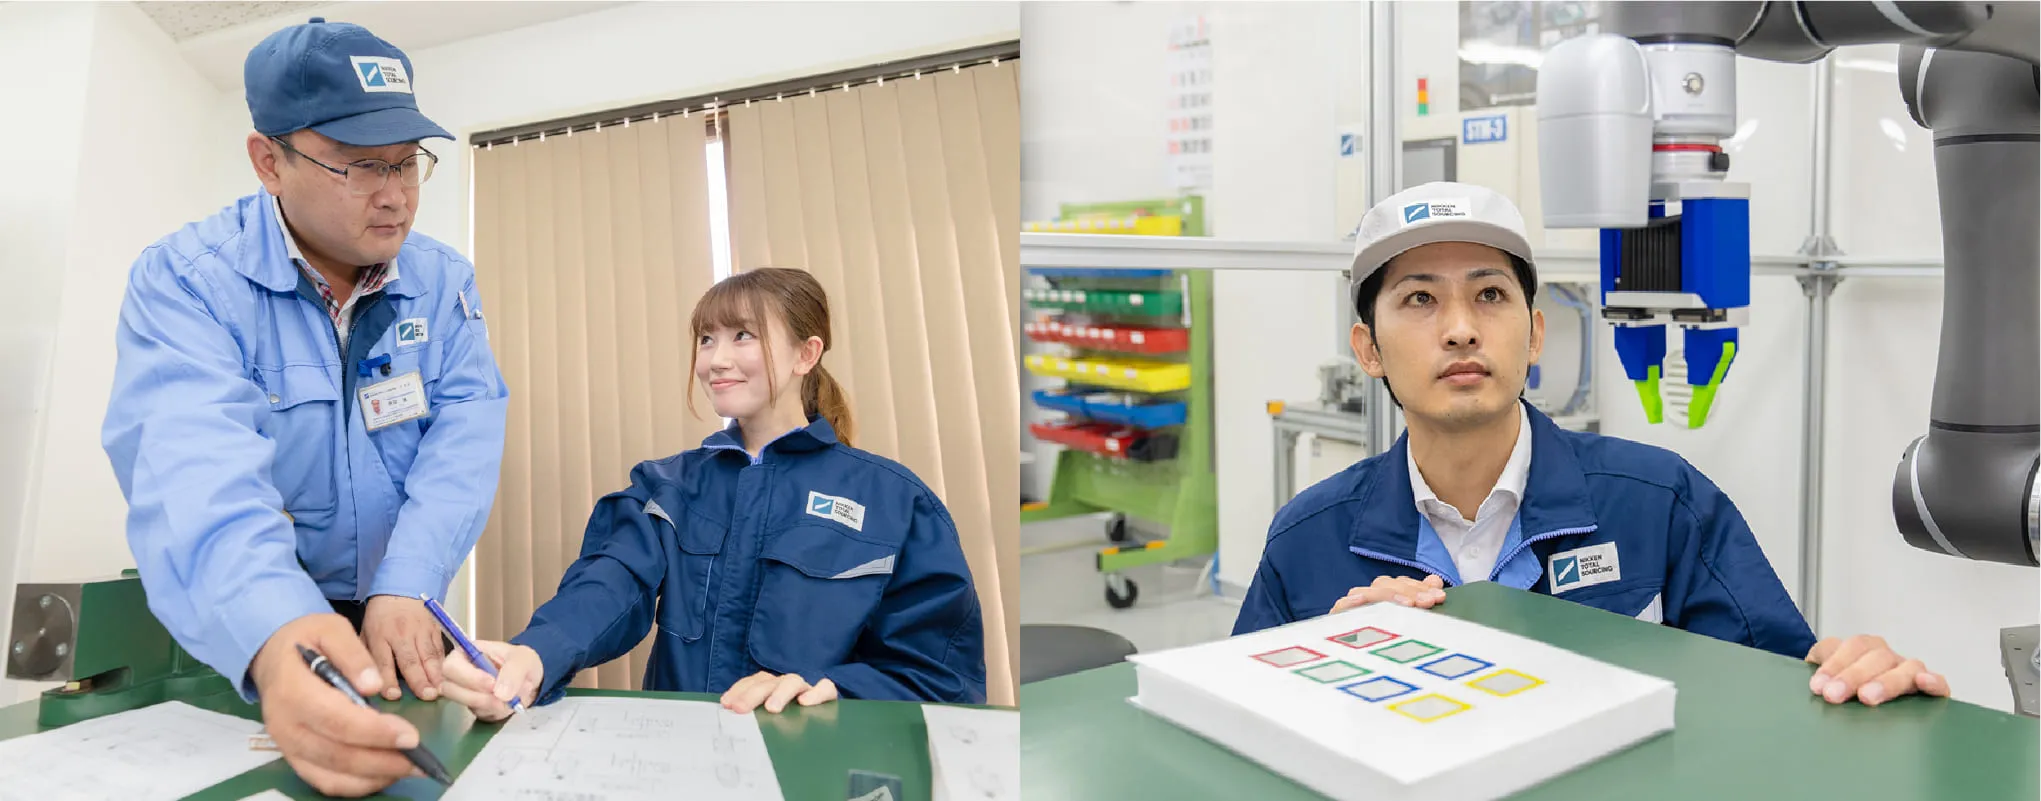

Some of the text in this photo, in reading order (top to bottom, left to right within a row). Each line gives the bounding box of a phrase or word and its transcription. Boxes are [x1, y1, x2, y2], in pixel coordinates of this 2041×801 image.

[1579, 554, 1603, 563] NIKKEN
[1580, 561, 1600, 570] TOTAL
[1581, 565, 1613, 577] SOURCING
